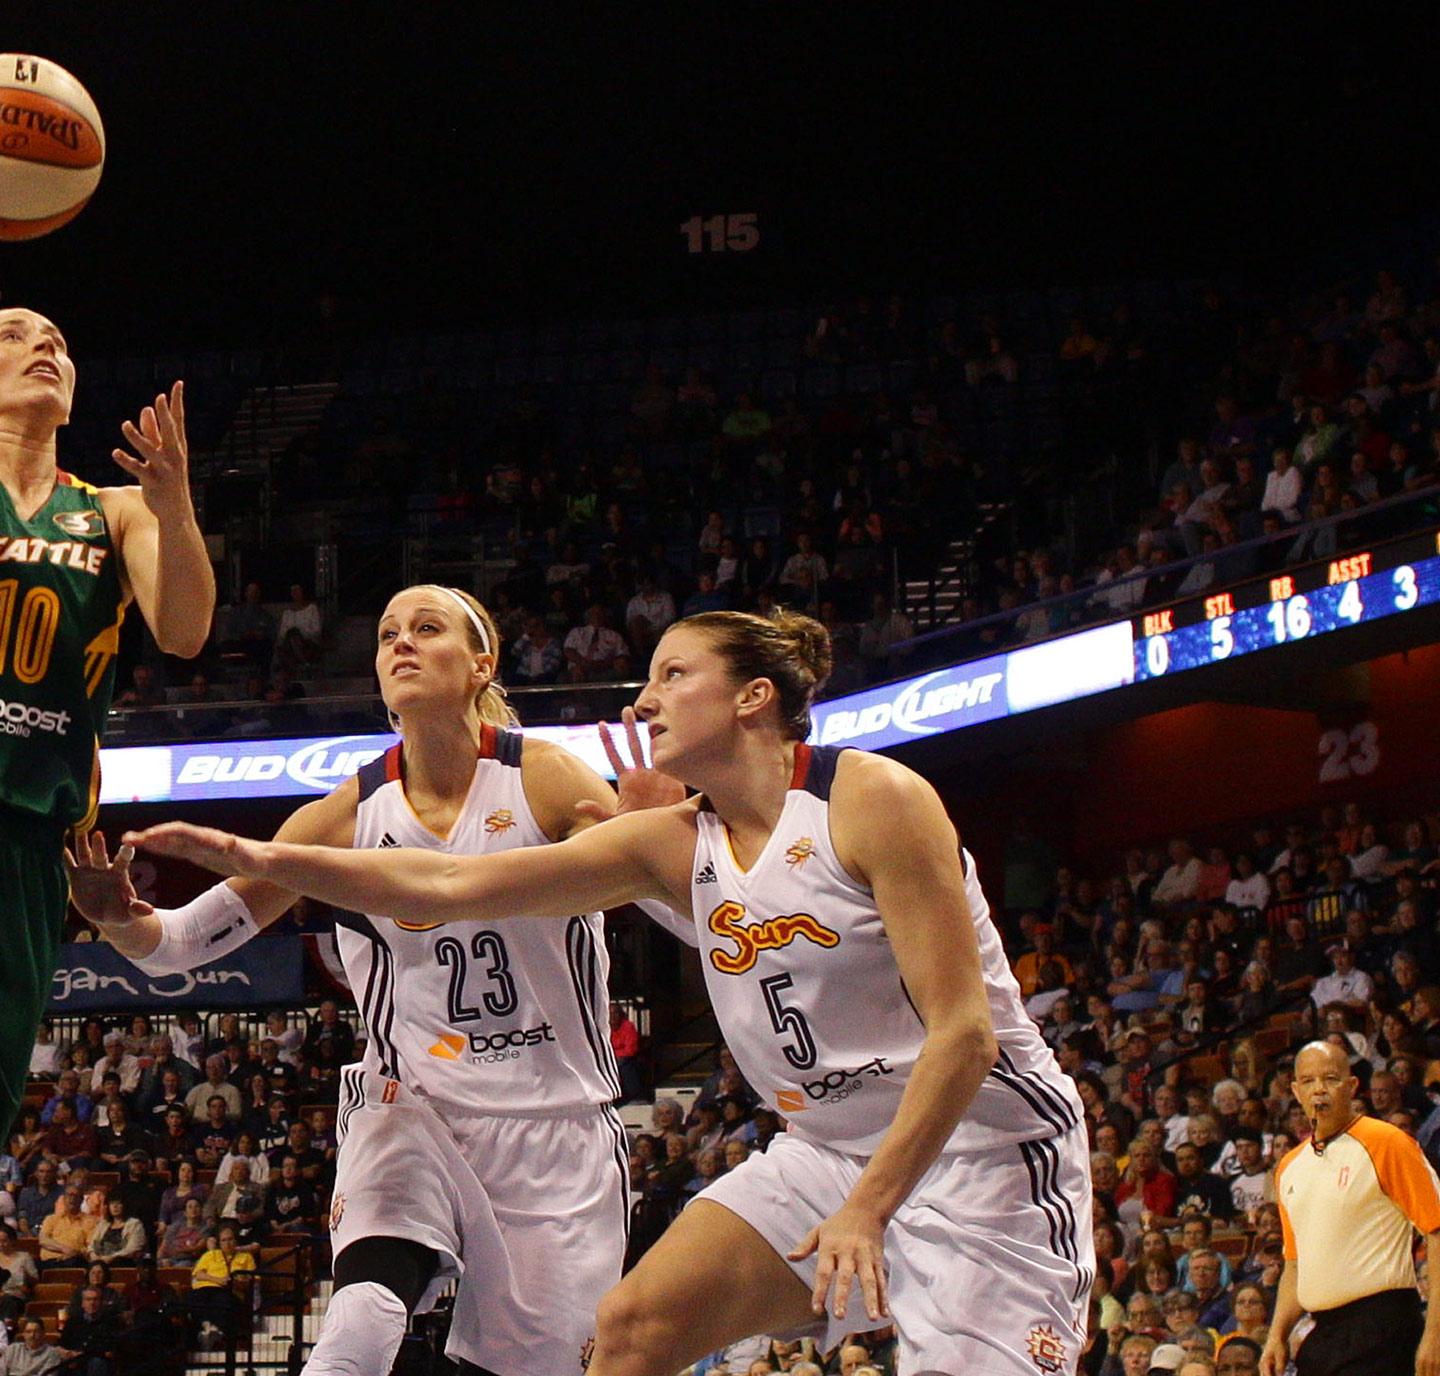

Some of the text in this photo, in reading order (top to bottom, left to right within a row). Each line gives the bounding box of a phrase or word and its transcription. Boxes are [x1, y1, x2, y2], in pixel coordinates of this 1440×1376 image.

[680, 213, 760, 252] 115
[1143, 553, 1371, 637] BLK STL RB ASST
[1146, 565, 1418, 676] 0 5 16 4 3
[820, 672, 1003, 746] BUD LIGHT
[176, 755, 286, 784] BUD
[1318, 722, 1379, 783] 23
[708, 900, 840, 975] Sun
[435, 930, 518, 1023] 23
[468, 1022, 555, 1053] boost
[472, 1050, 521, 1064] mobile
[760, 972, 817, 1070] 5
